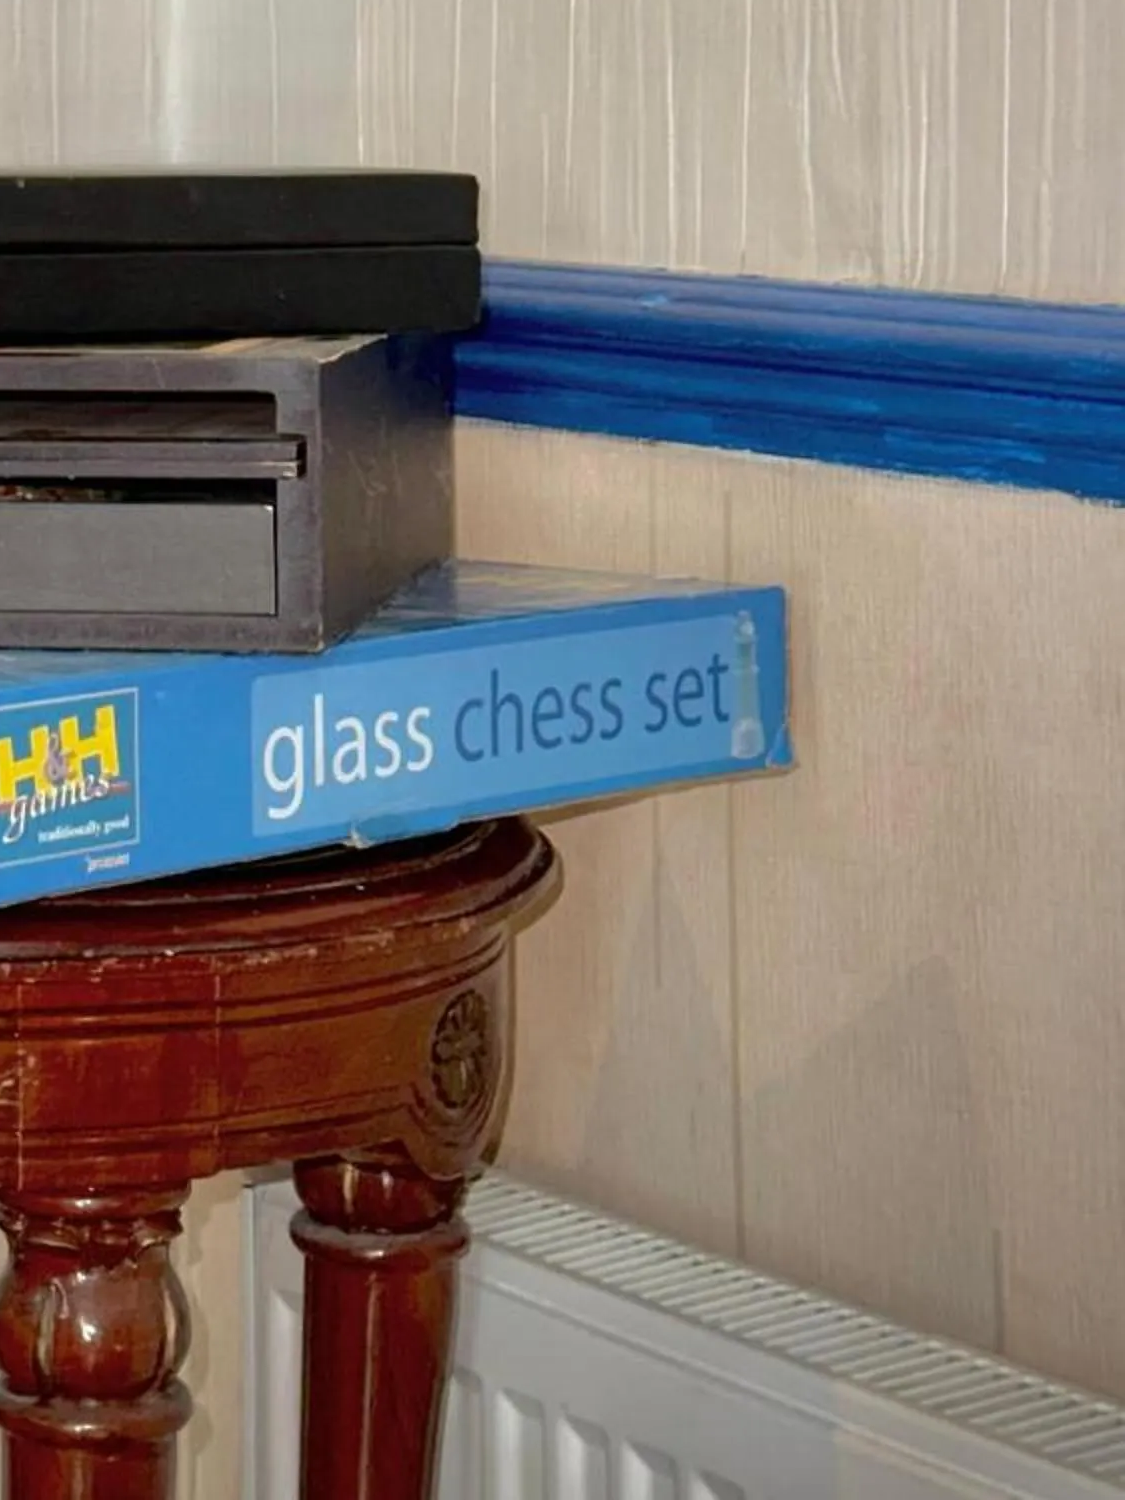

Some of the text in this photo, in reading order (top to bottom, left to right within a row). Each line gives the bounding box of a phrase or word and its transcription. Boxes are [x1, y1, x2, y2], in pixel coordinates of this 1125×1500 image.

[263, 653, 731, 820] glass chess set
[1, 772, 111, 844] games
